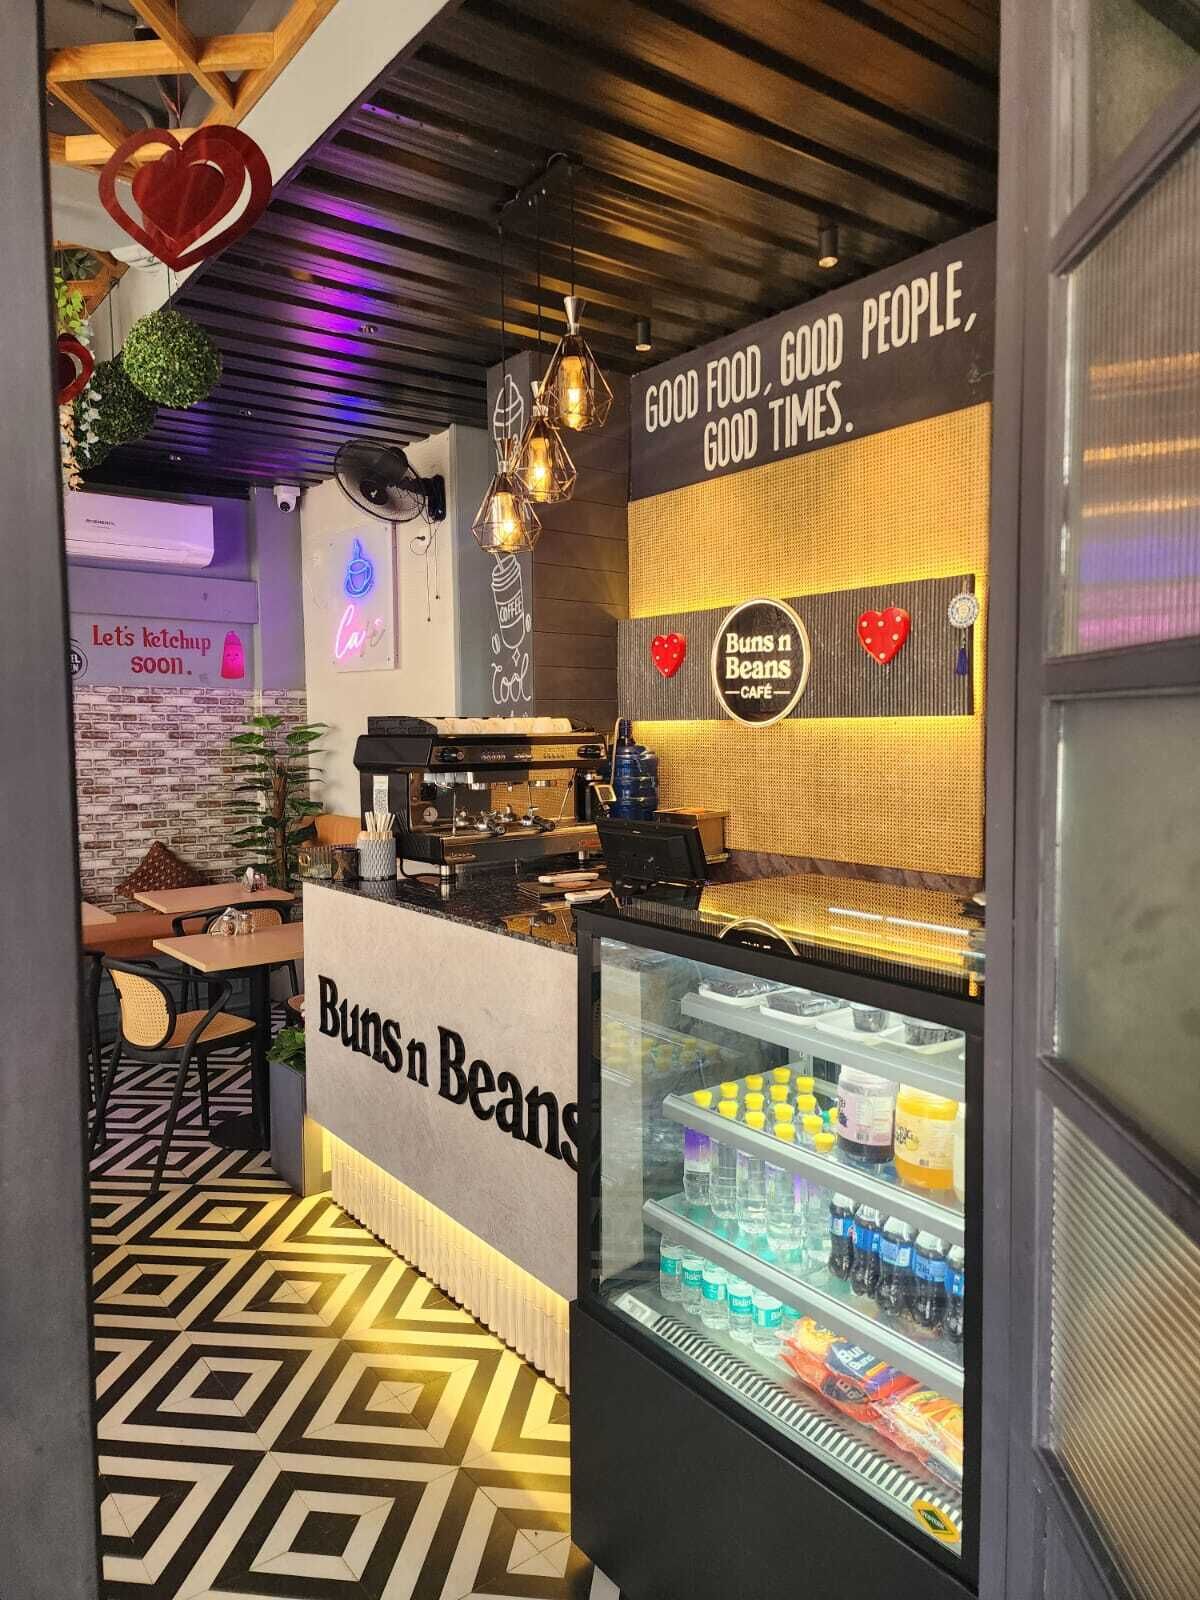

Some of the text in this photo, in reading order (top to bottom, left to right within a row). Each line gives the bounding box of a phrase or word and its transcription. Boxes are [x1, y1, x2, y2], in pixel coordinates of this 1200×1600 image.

[645, 260, 977, 433] GOOD FOOD, GOOD PEOPLE,
[704, 380, 854, 471] GOOD TIMES.
[499, 595, 522, 623] COFFEE
[92, 624, 212, 656] Let's ketchup
[726, 632, 792, 654] Buns n
[131, 656, 193, 675] soon.
[491, 652, 531, 704] Cool
[725, 656, 792, 679] Beans
[740, 682, 773, 699] CAFÉ
[318, 974, 579, 1172] Buns n Beans
